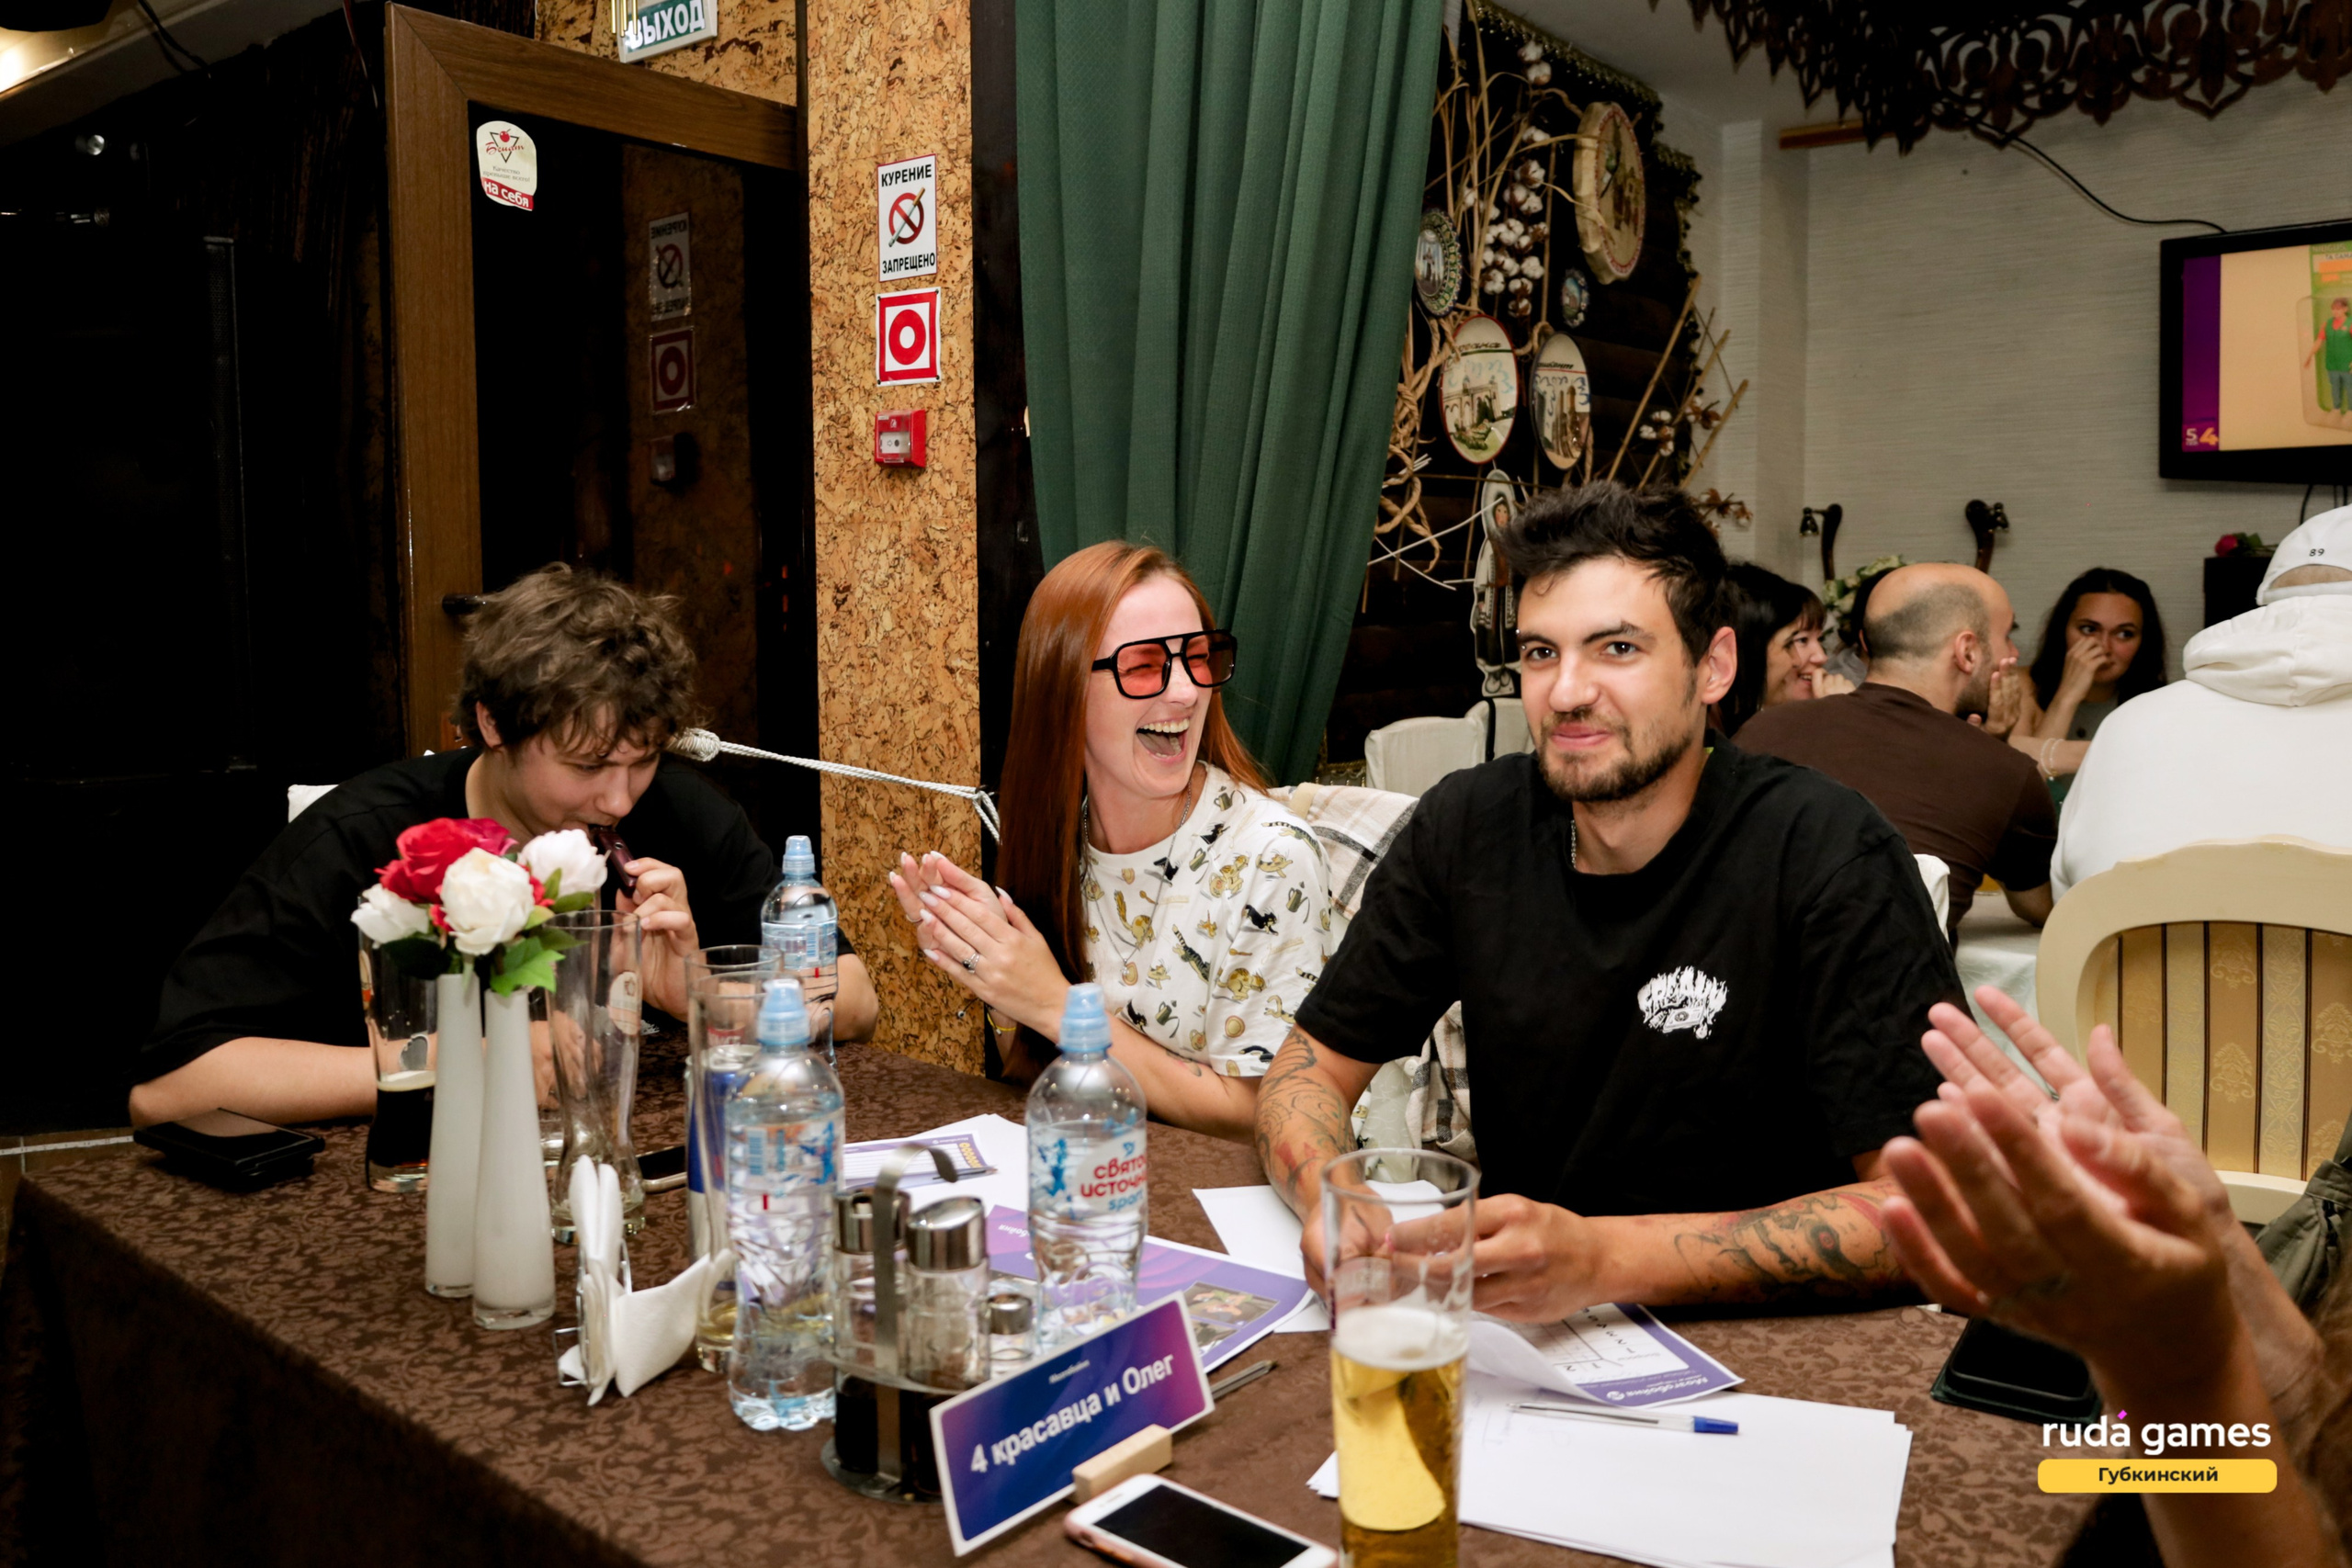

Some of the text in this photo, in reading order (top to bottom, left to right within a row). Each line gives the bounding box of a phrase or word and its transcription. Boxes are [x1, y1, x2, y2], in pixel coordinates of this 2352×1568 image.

[625, 0, 706, 50] ВЫХОД
[881, 164, 932, 187] КУРЕНИЕ
[501, 188, 529, 208] себя
[882, 253, 935, 274] ЗАПРЕЩЕНО
[2309, 547, 2325, 557] 89
[970, 1354, 1174, 1473] 4 красавца и Олег
